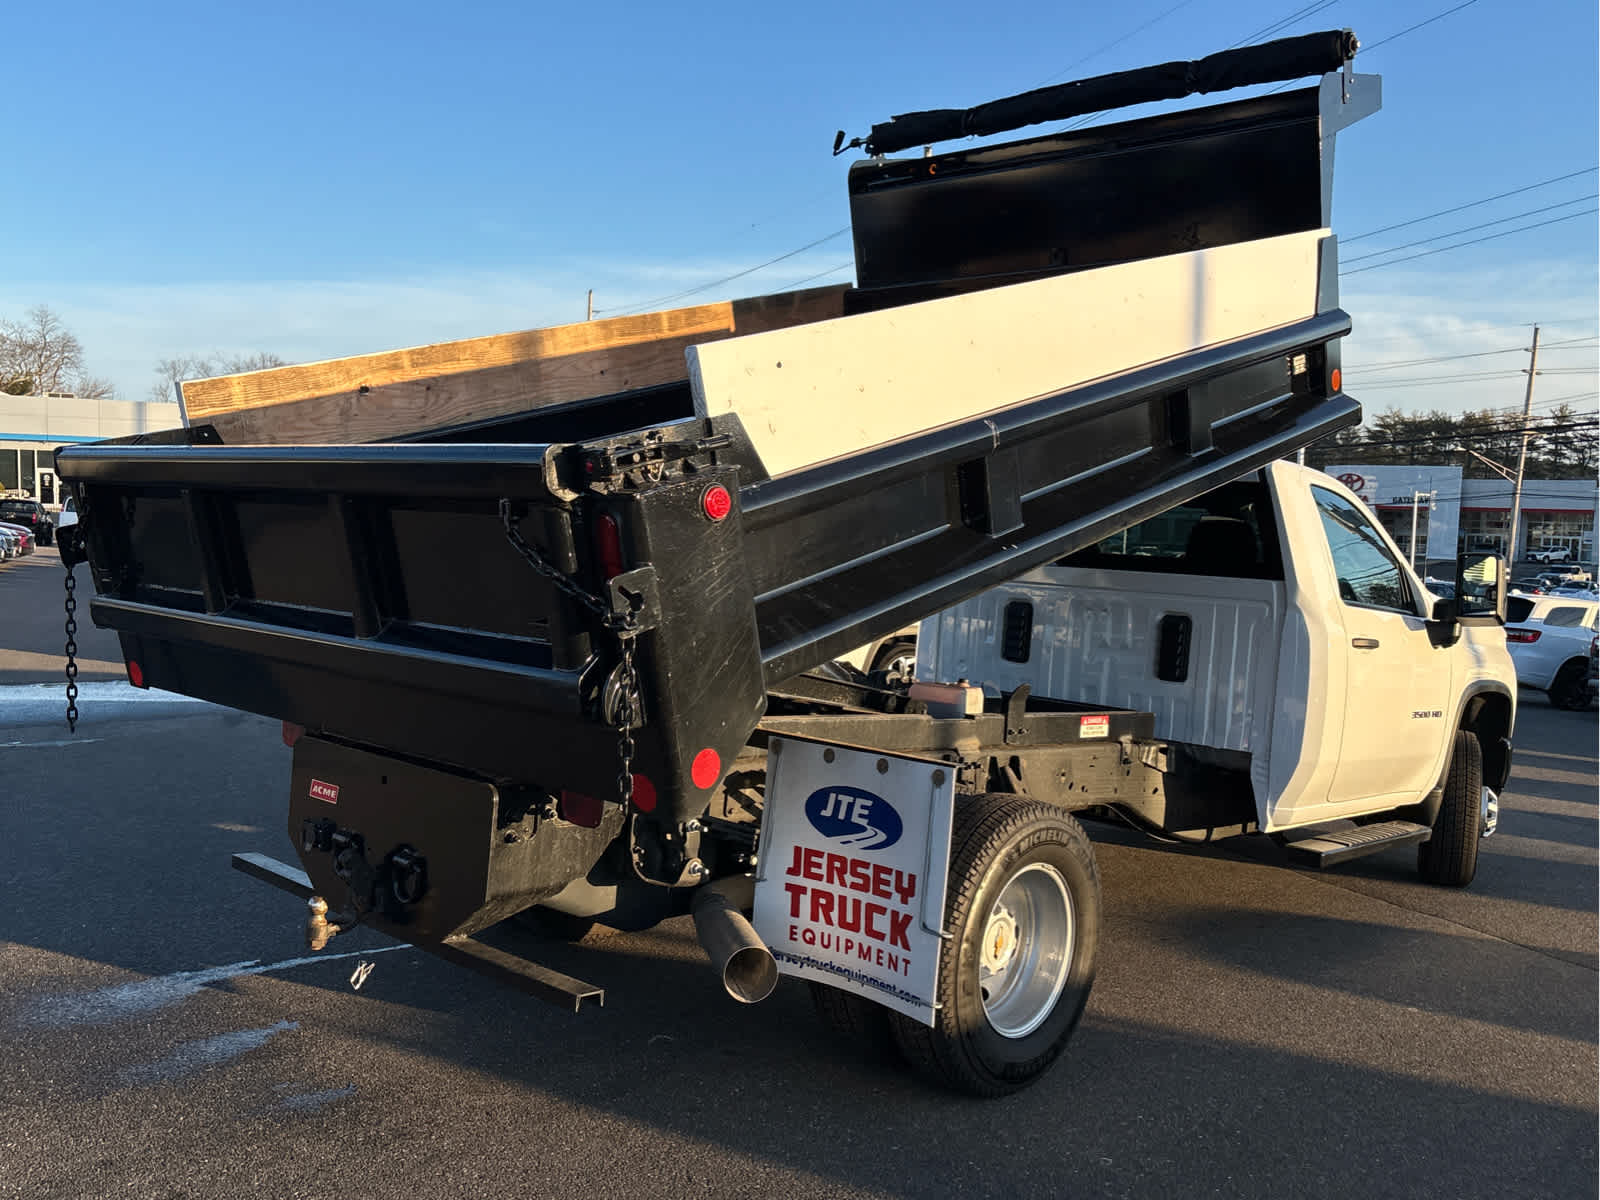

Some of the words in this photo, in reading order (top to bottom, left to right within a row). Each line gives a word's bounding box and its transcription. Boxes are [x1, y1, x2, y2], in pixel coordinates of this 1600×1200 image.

[1392, 496, 1431, 504] GATEAY
[312, 785, 336, 798] ACME
[820, 792, 874, 825] JTE
[785, 845, 917, 906] JERSEY
[784, 882, 914, 952] TRUCK
[788, 924, 912, 977] EQUIPMENT
